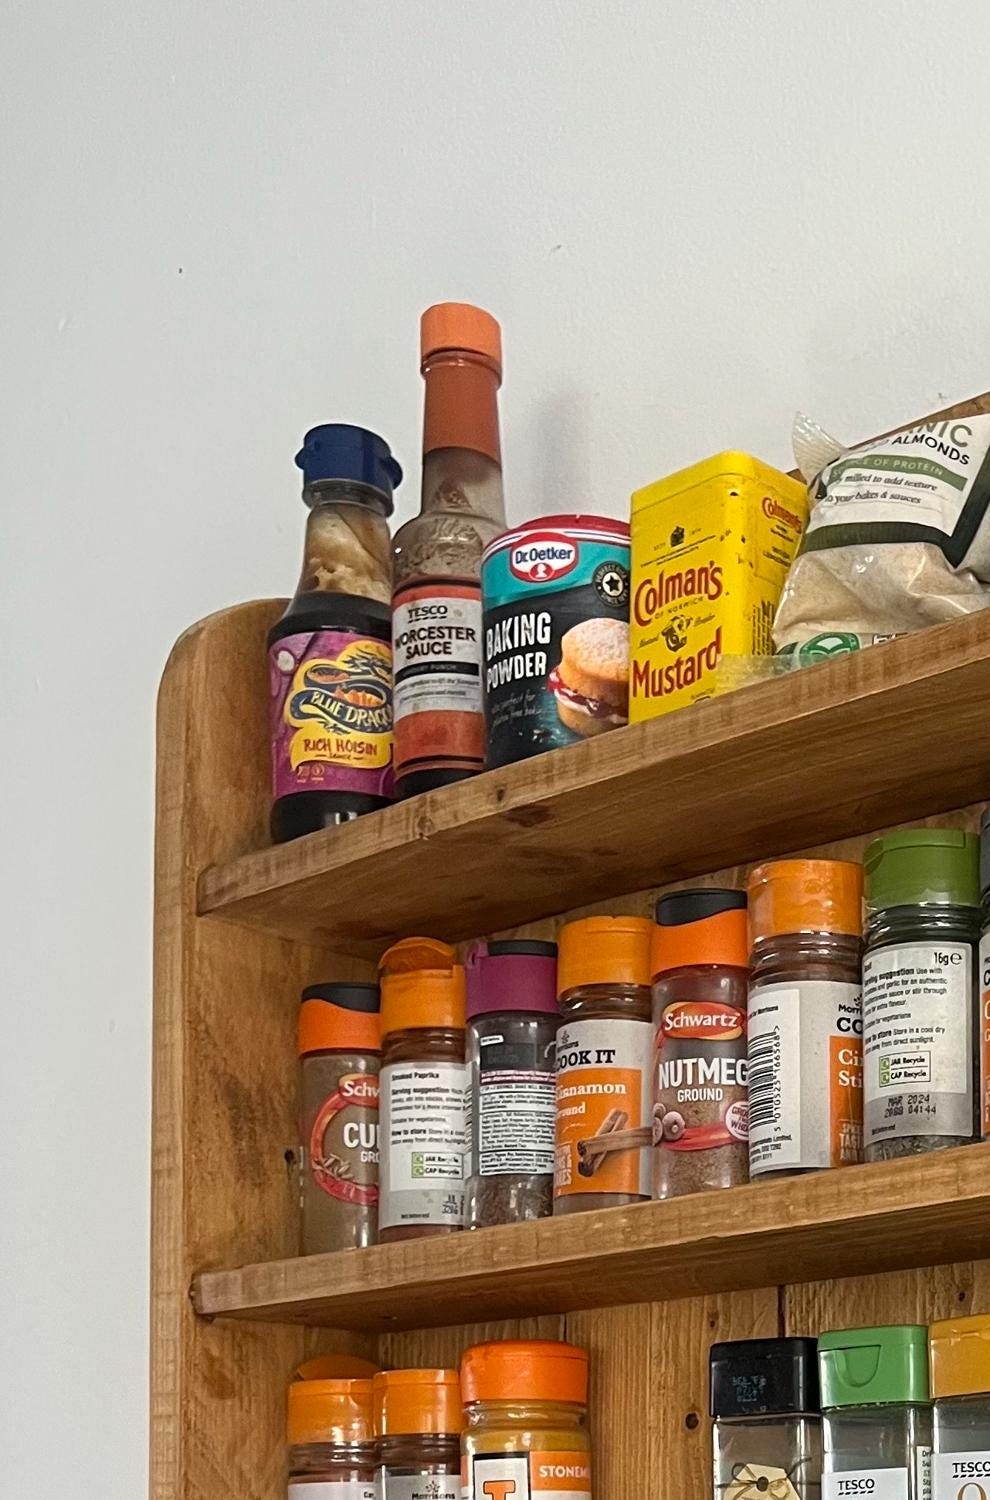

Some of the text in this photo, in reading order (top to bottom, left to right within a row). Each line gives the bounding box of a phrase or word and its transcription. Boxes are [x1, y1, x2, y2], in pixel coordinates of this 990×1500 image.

[892, 433, 971, 465] ALMONDS
[874, 458, 944, 476] OF PROTEIN
[873, 474, 882, 483] to
[884, 476, 902, 485] add
[904, 479, 938, 492] texture
[634, 560, 723, 627] Colman's
[408, 605, 448, 618] TESCO
[486, 612, 551, 661] BAKING
[406, 642, 452, 660] SAUCE
[632, 626, 722, 698] Mustard
[487, 651, 547, 693] POWDER
[311, 691, 393, 728] BLUE DRAGO
[304, 738, 378, 755] RICH HOISIN
[934, 952, 949, 965] 16g
[665, 1012, 741, 1031] Schwartz
[557, 1049, 616, 1072] OOK IT
[659, 1057, 750, 1090] NUTMEG
[677, 1088, 723, 1102] GROUND
[343, 1122, 380, 1149] CU
[838, 1478, 875, 1491] TESCO
[412, 1491, 455, 1500] Morrisons
